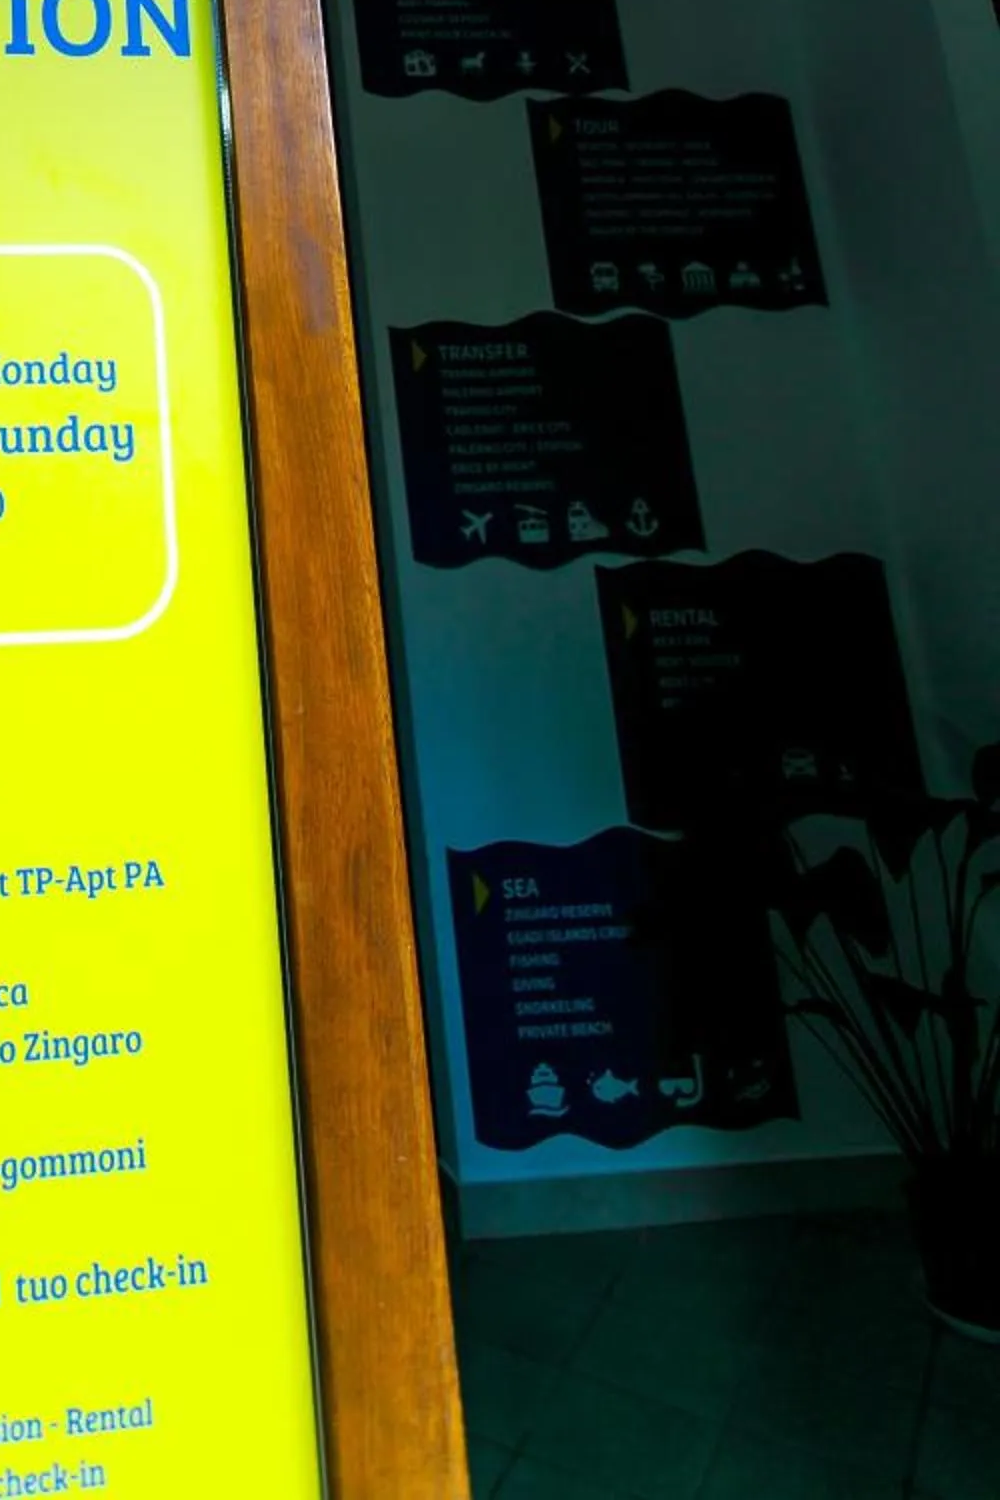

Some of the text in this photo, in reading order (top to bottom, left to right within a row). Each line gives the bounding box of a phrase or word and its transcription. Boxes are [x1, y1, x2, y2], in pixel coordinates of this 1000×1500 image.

[438, 342, 532, 361] TRANSFER
[649, 607, 720, 628] RENTAL
[15, 866, 117, 899] TP-Apt
[124, 860, 165, 889] PA
[501, 877, 540, 900] SEA
[23, 1030, 142, 1067] Zingaro
[15, 1274, 68, 1303] tuo
[75, 1254, 208, 1297] check-in
[66, 1399, 153, 1435] Rental
